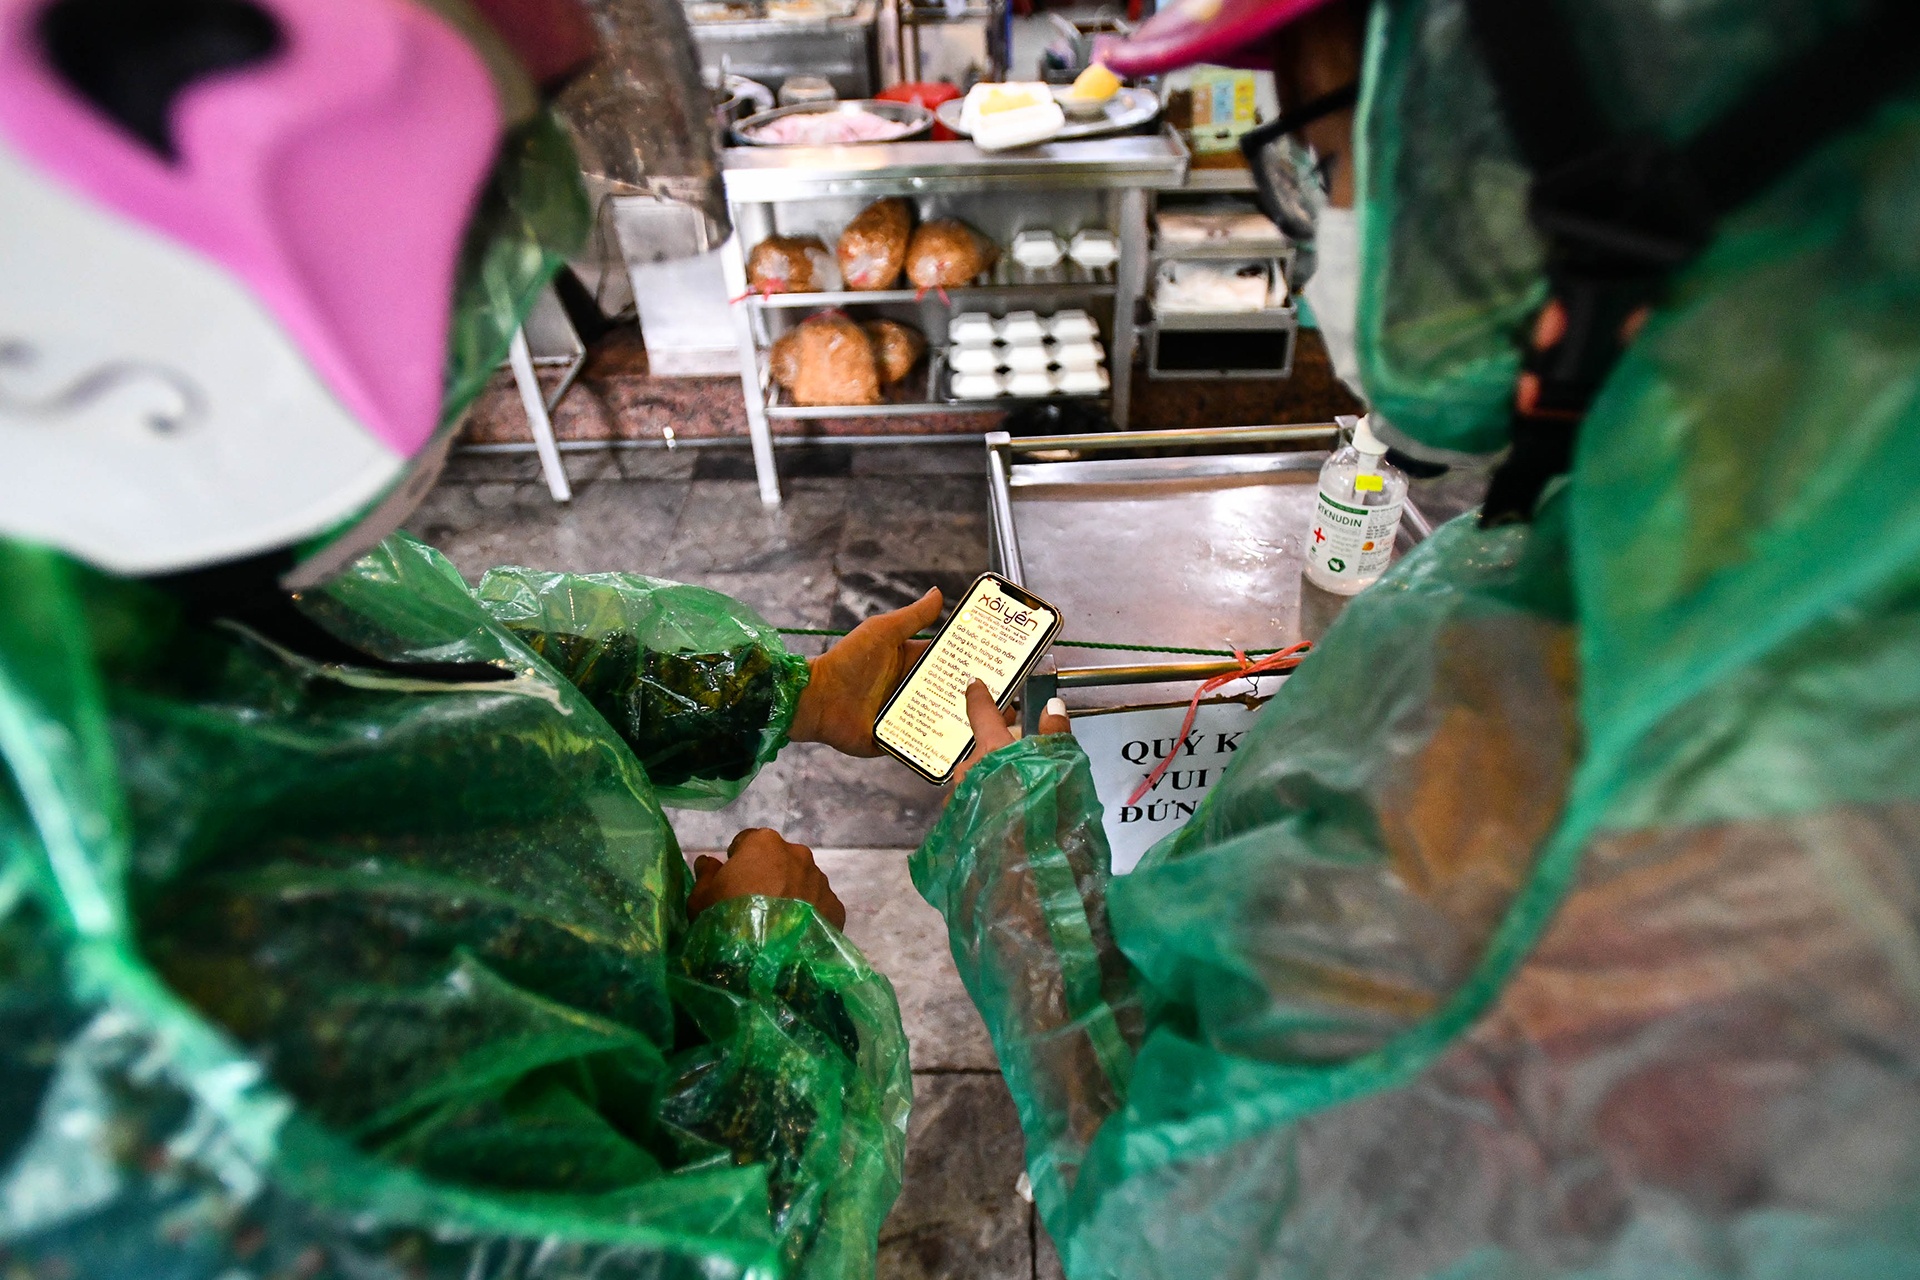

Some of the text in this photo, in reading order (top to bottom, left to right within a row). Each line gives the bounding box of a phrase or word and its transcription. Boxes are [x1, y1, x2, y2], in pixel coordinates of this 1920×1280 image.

[1121, 729, 1247, 766] QUÝ K
[1142, 768, 1210, 792] VUI
[1118, 798, 1200, 824] ĐỨN
